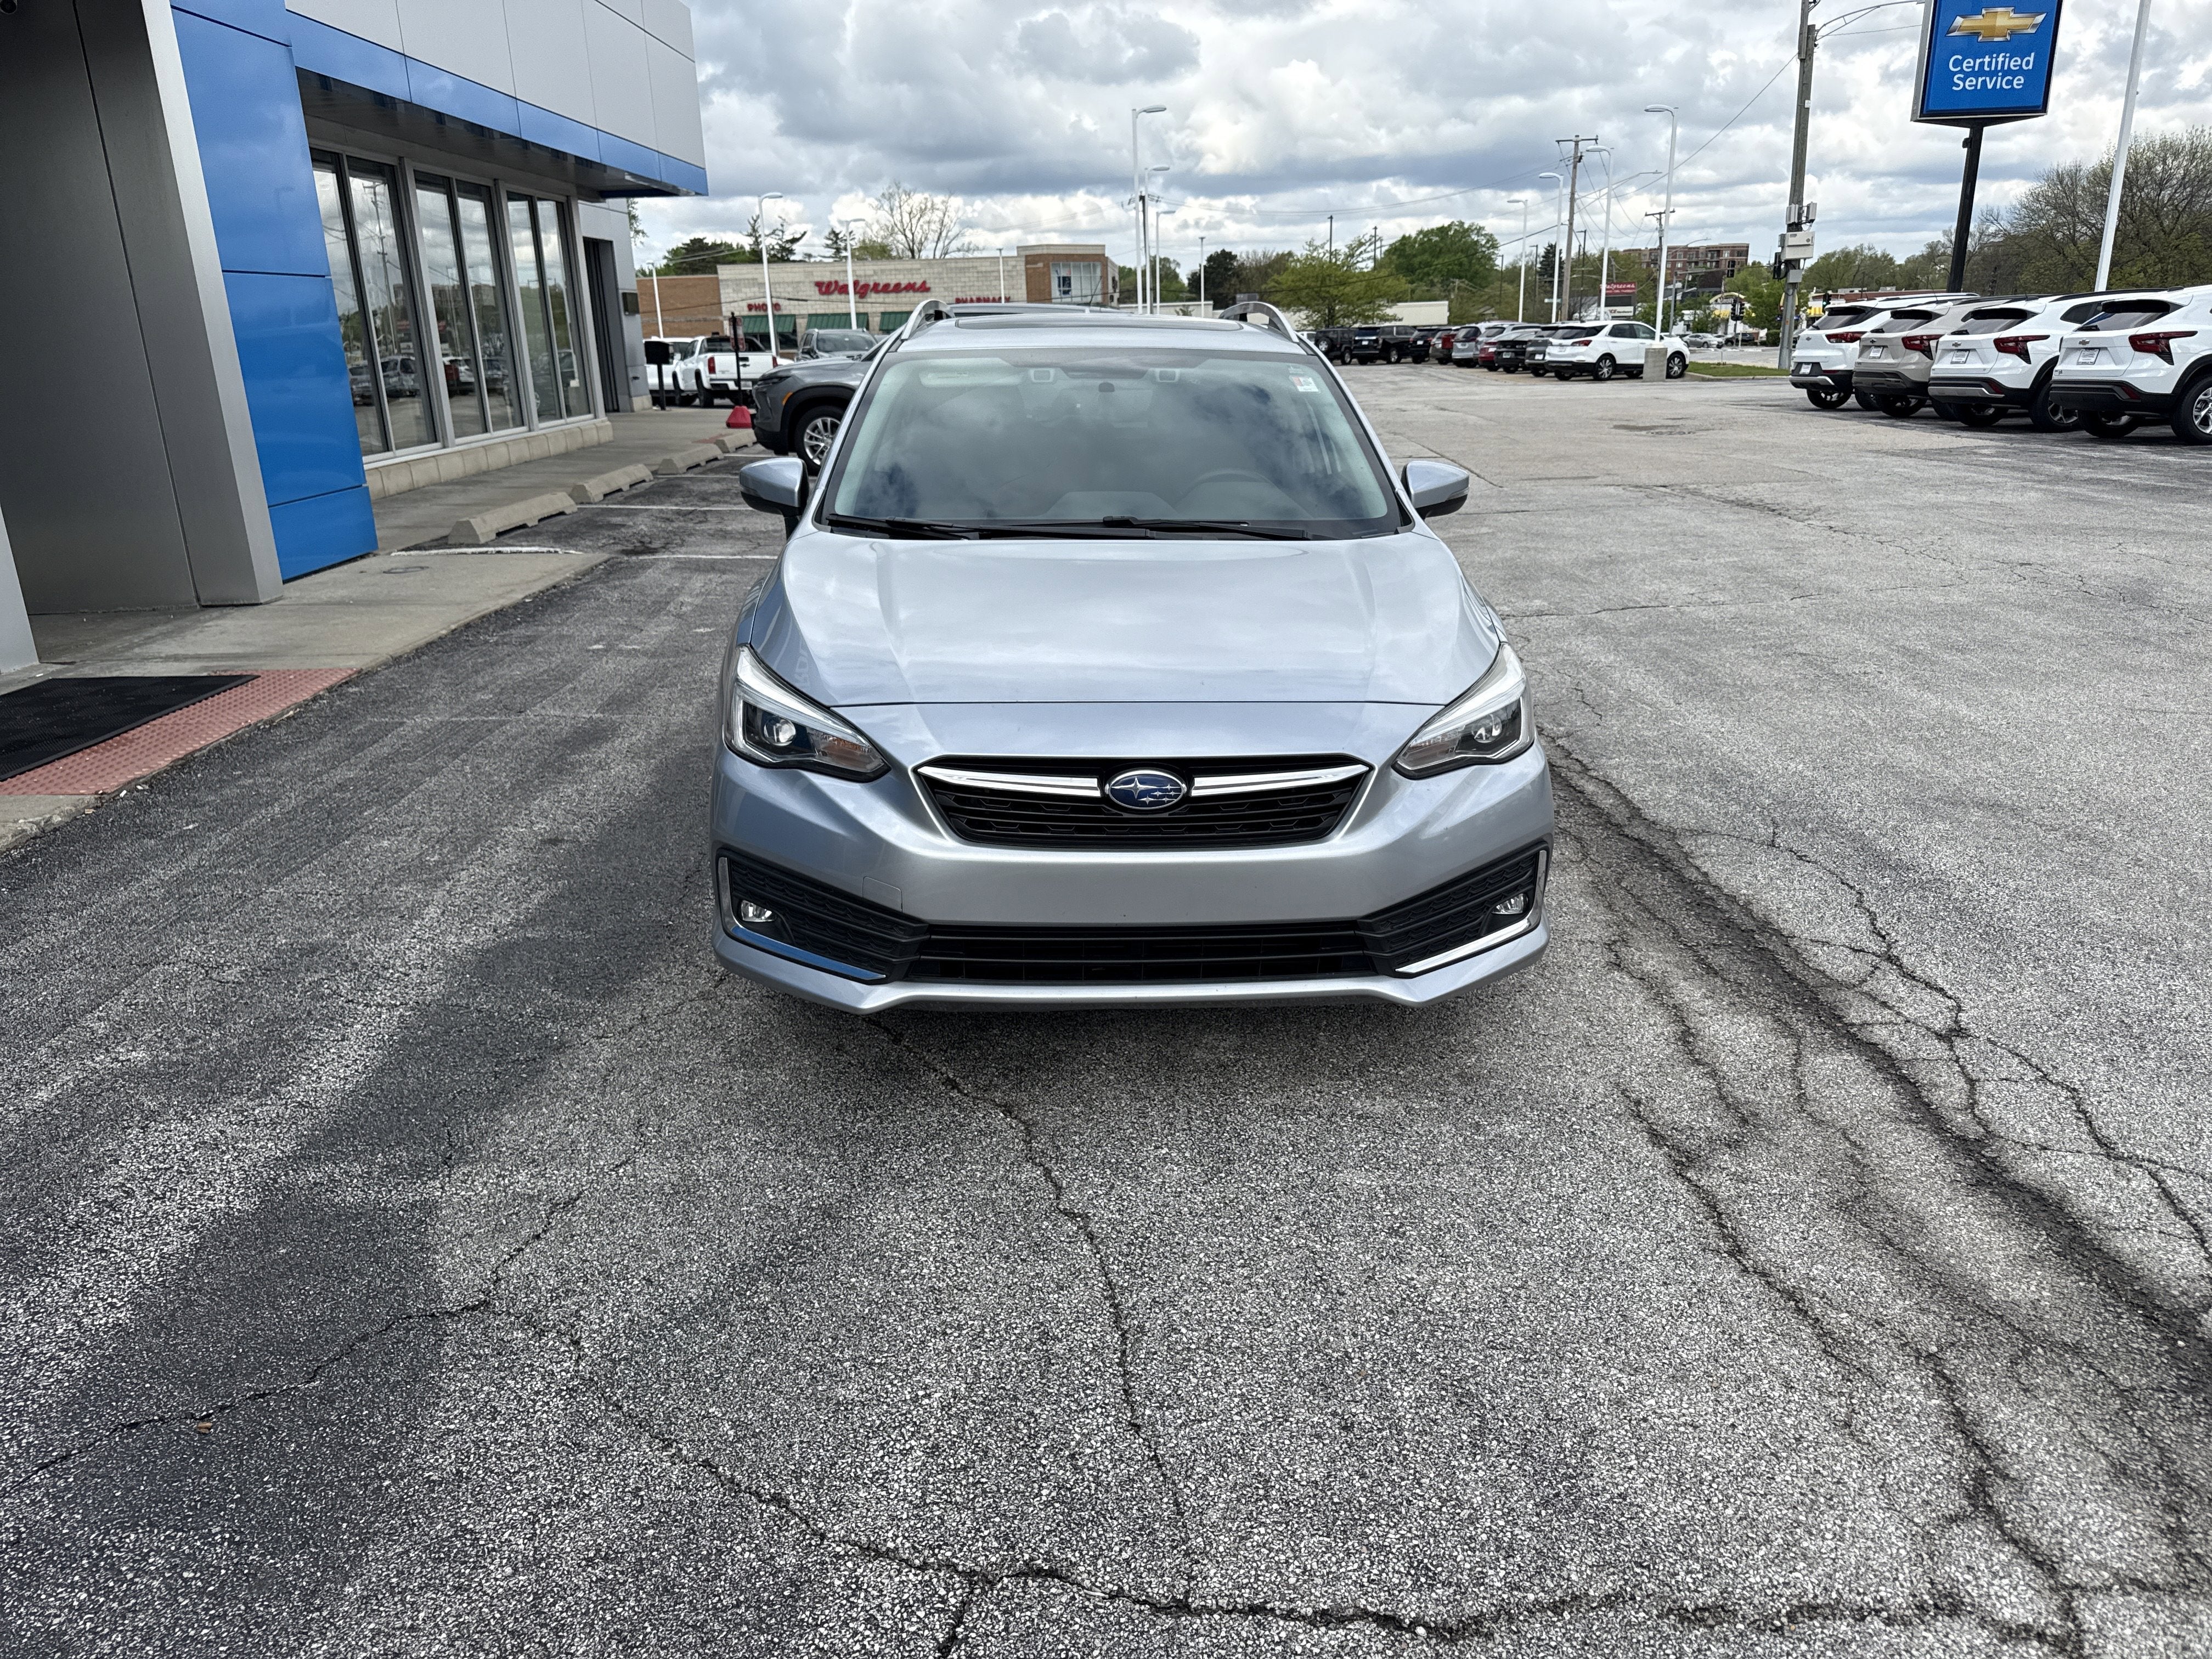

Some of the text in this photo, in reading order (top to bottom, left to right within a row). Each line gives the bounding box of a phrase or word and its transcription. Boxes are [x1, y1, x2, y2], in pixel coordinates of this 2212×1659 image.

[1949, 52, 2035, 72] Certified
[1951, 72, 2024, 91] Service
[814, 279, 931, 299] Walgreens
[747, 302, 781, 312] PHOO
